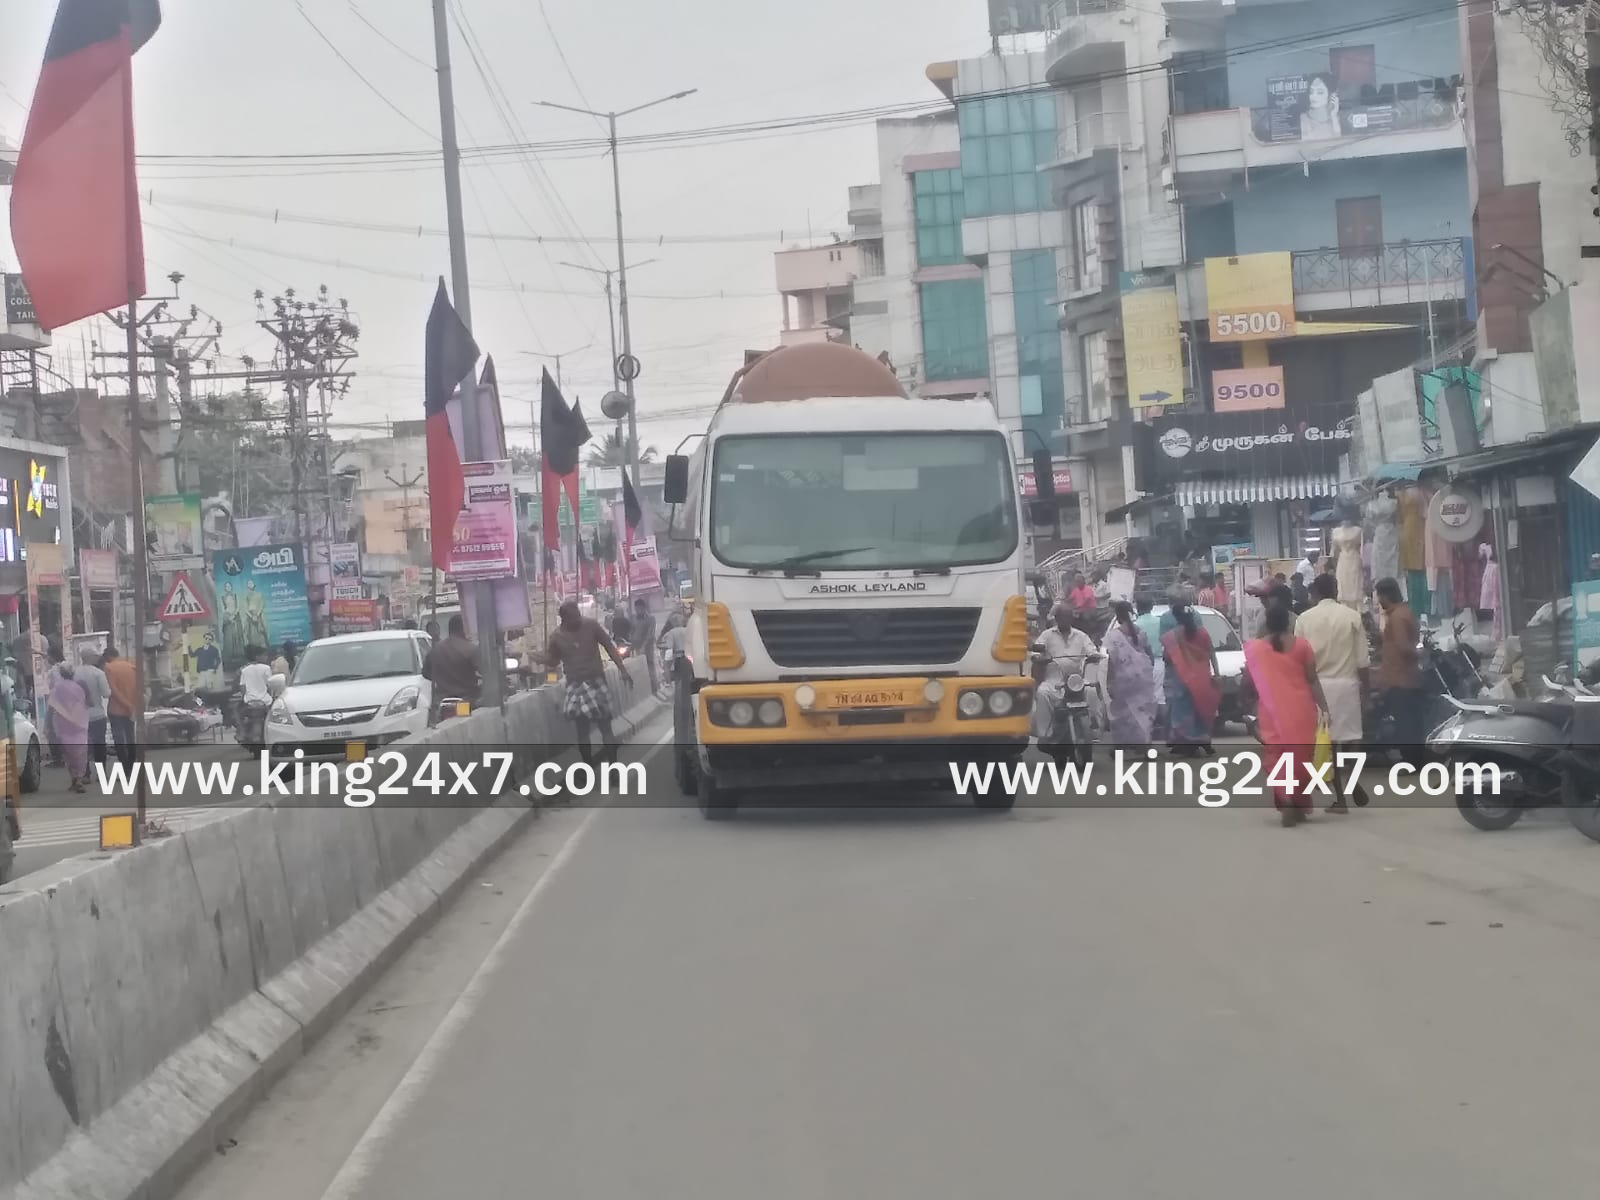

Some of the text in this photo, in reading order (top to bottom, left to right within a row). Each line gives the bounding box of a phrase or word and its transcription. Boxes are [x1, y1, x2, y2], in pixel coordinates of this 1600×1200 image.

[1217, 382, 1280, 400] 9500
[1212, 424, 1295, 452] முருகன்
[809, 582, 926, 593] ASHOK LEYLAND
[835, 694, 848, 704] TN
